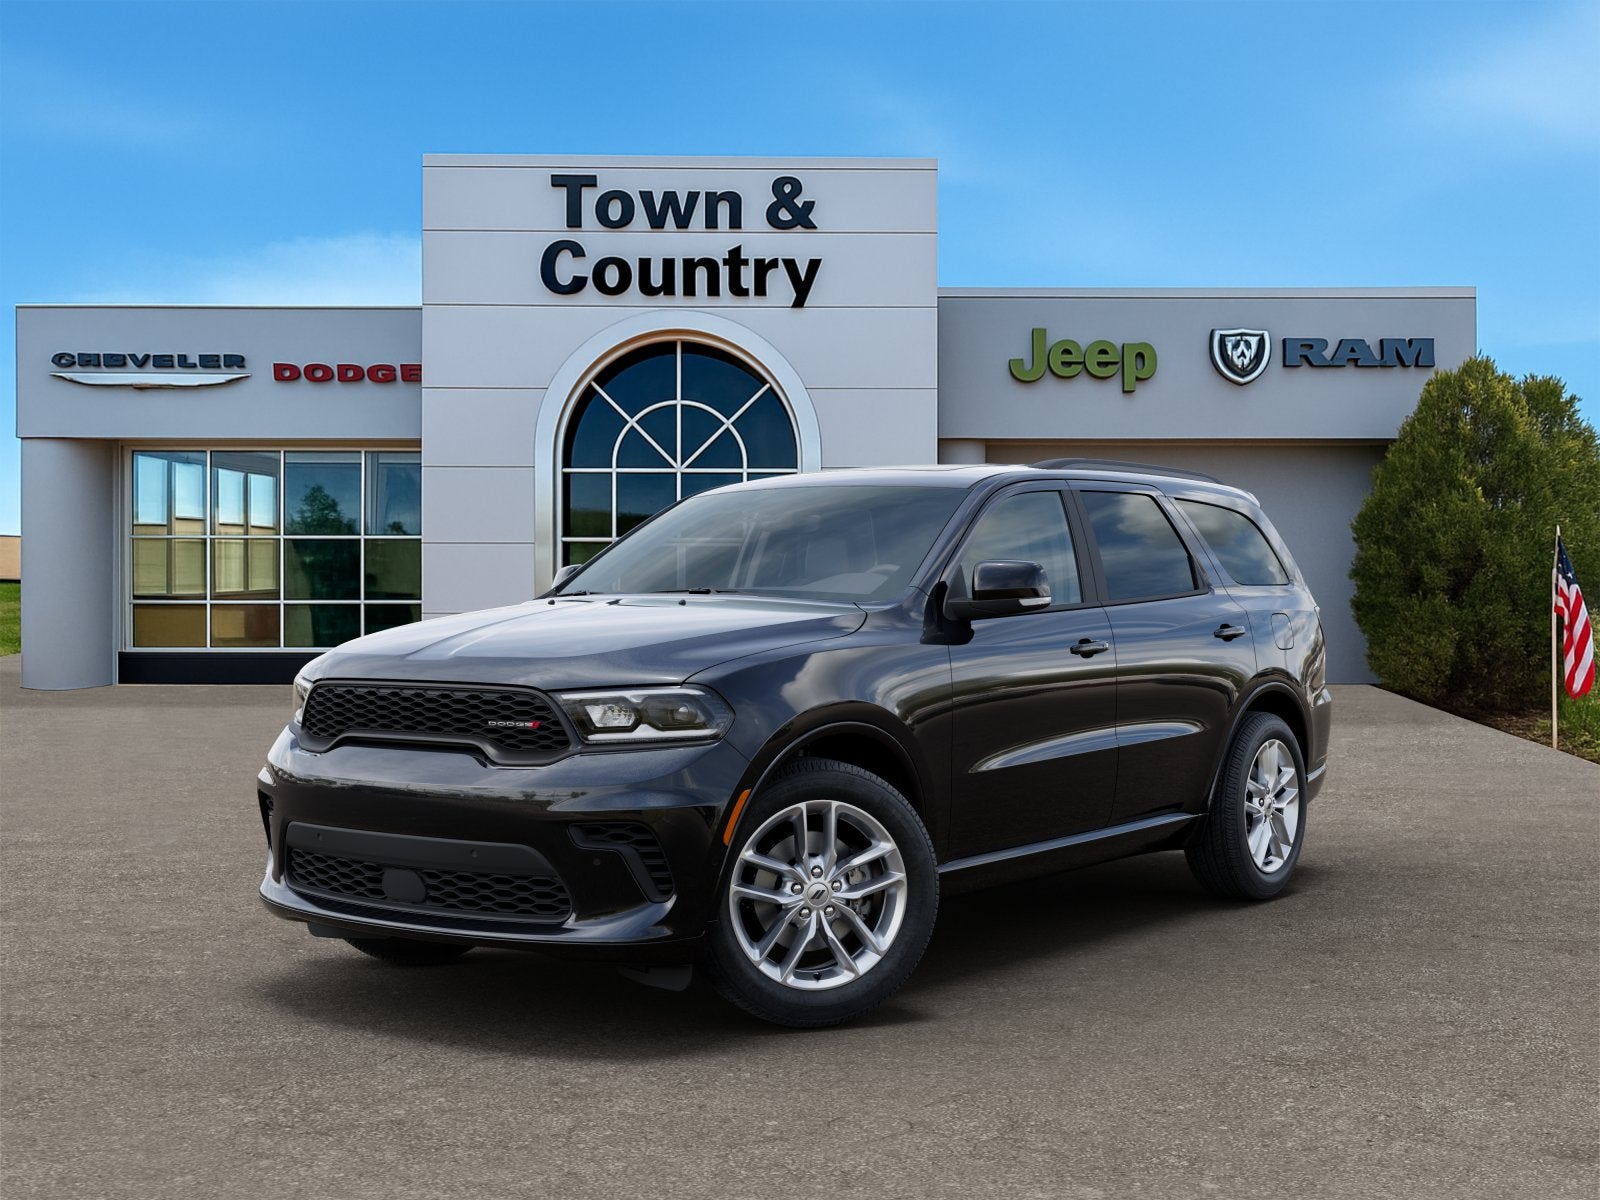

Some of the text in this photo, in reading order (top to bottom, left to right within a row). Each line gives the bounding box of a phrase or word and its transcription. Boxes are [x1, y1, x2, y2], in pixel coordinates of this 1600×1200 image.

[551, 174, 818, 229] Town &
[540, 240, 822, 308] Country
[273, 363, 422, 382] DODGE
[1009, 328, 1157, 393] Jeep
[1283, 338, 1435, 368] RAM
